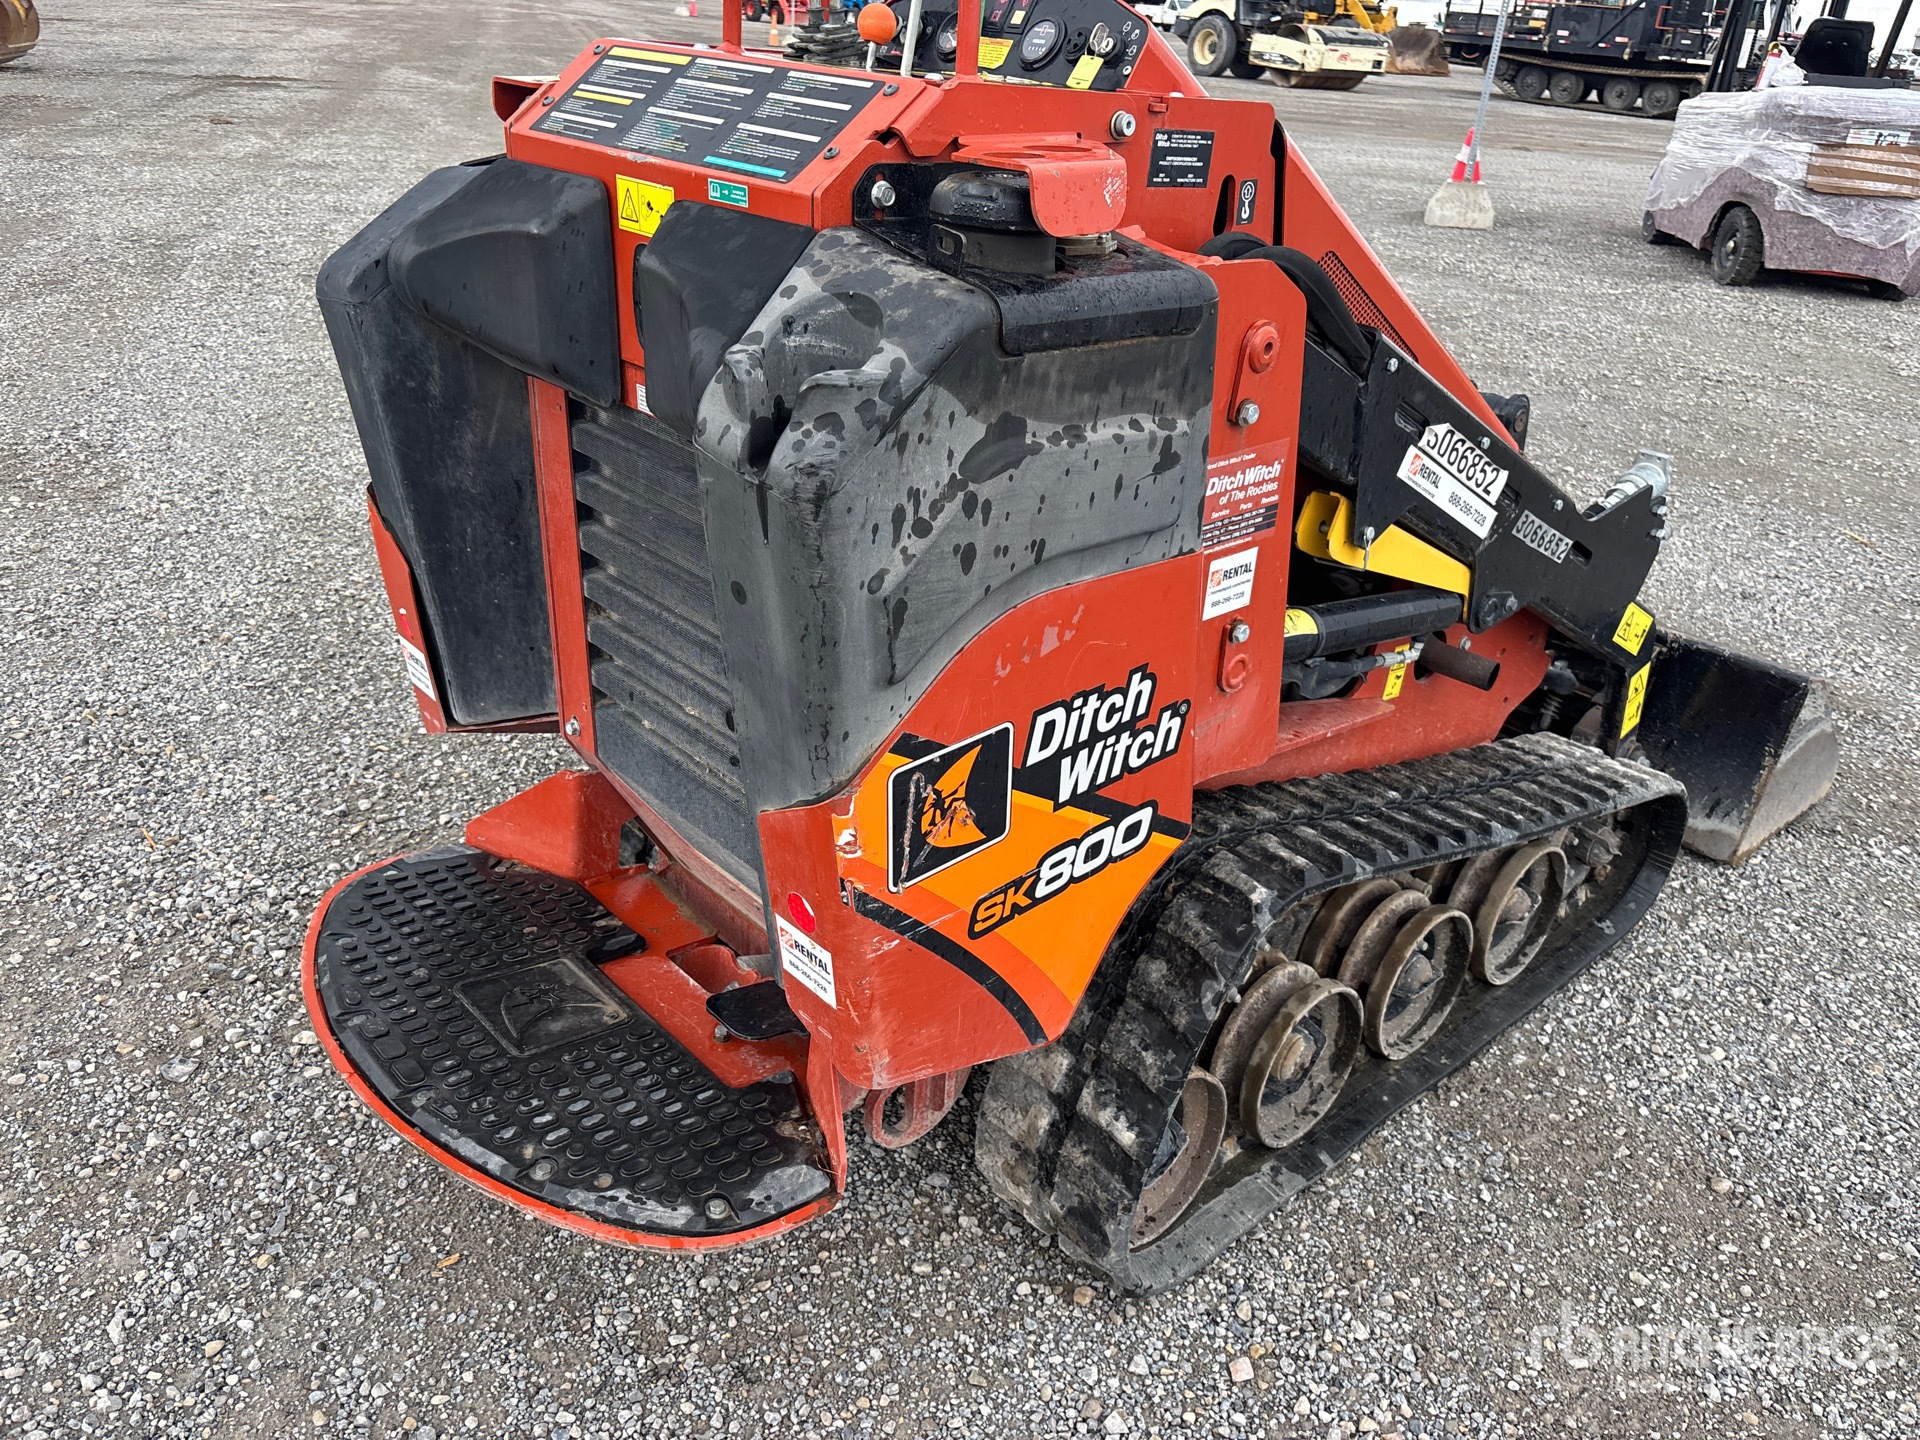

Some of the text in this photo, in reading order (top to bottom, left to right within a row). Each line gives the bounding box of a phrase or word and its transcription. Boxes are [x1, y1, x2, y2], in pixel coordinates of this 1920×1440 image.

[1205, 470, 1244, 497] Ditch
[1417, 463, 1442, 489] RENTAL
[1219, 481, 1279, 505] of The Rockies
[1239, 502, 1253, 511] Parts
[1211, 508, 1230, 519] Service
[1448, 492, 1487, 527] 888-266-7228
[1516, 514, 1569, 561] 3066852
[1222, 562, 1252, 581] RENTAL
[1026, 671, 1153, 767] Ditch
[974, 806, 1153, 932] SK800
[793, 939, 831, 976] RENTAL
